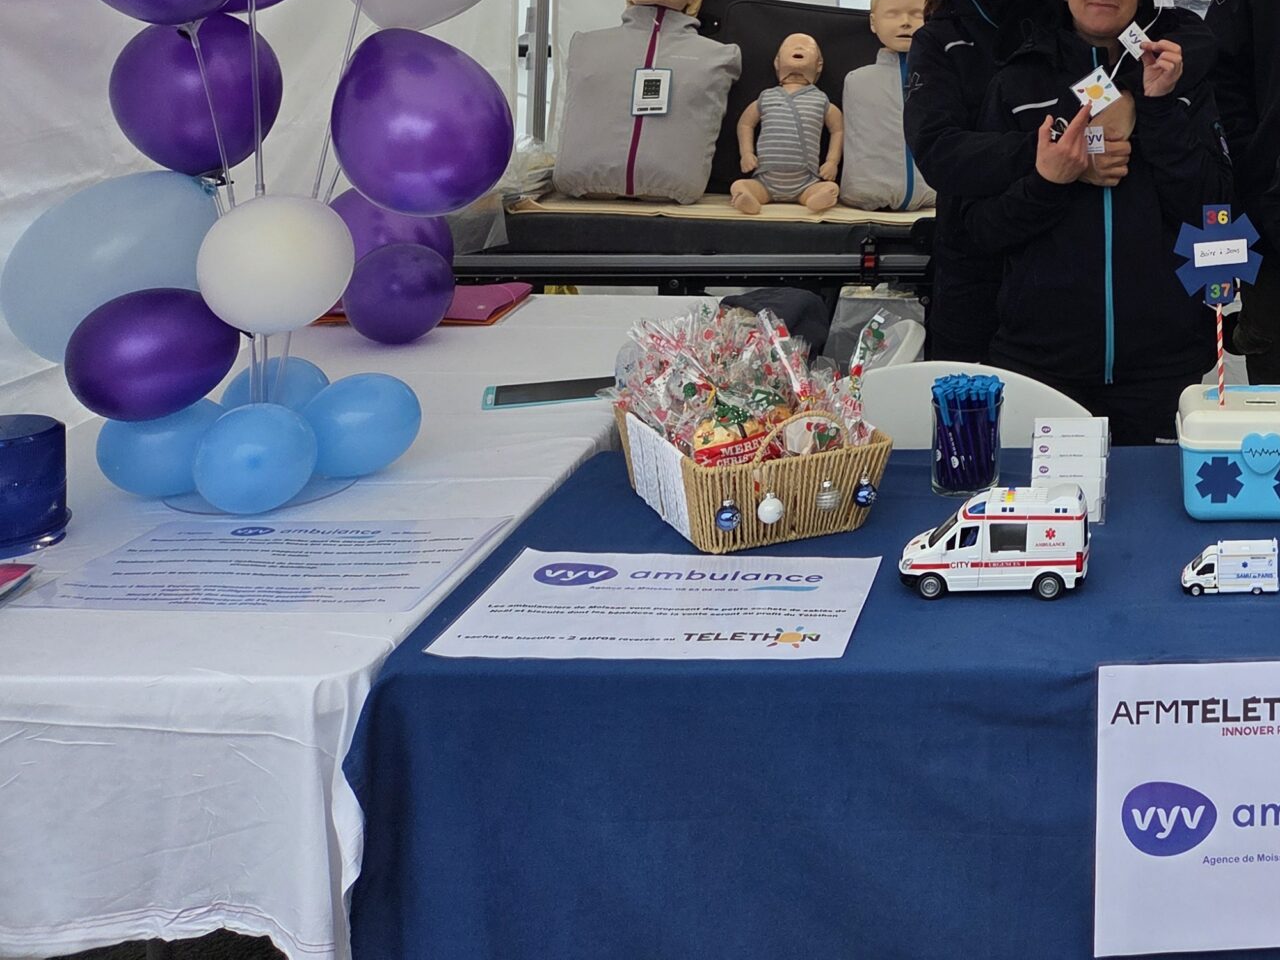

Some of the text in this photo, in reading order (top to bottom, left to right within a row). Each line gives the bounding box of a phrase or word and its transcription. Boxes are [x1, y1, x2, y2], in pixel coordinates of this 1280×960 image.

[1206, 210, 1229, 225] 36
[1210, 283, 1231, 298] 37
[280, 528, 382, 536] ambulance
[950, 561, 970, 569] CITY
[545, 569, 823, 583] vyv ambulance
[1221, 726, 1275, 737] INNOVER
[1130, 804, 1206, 840] vyv
[1202, 854, 1240, 866] Agence
[1242, 853, 1255, 864] de
